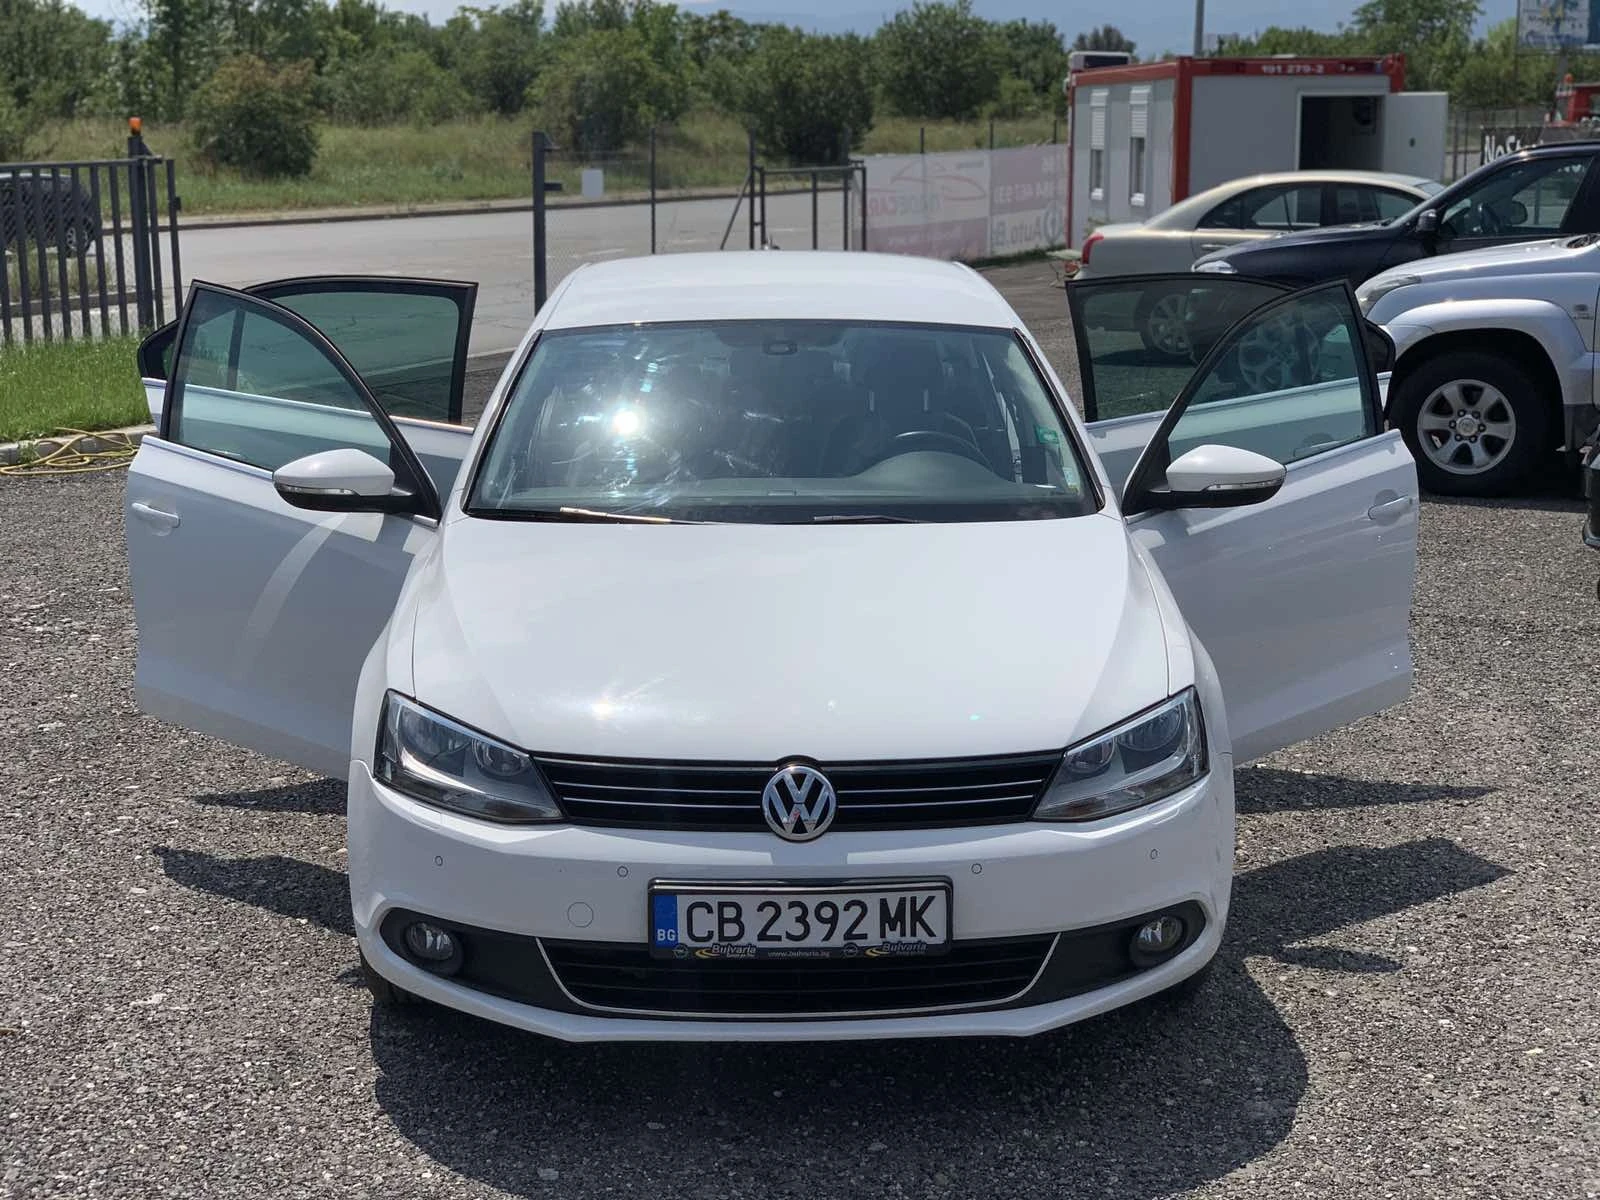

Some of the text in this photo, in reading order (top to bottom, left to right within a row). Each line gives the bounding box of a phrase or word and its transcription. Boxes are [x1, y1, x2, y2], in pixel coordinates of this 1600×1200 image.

[686, 896, 937, 943] CB 2392 MK
[657, 929, 676, 942] BG
